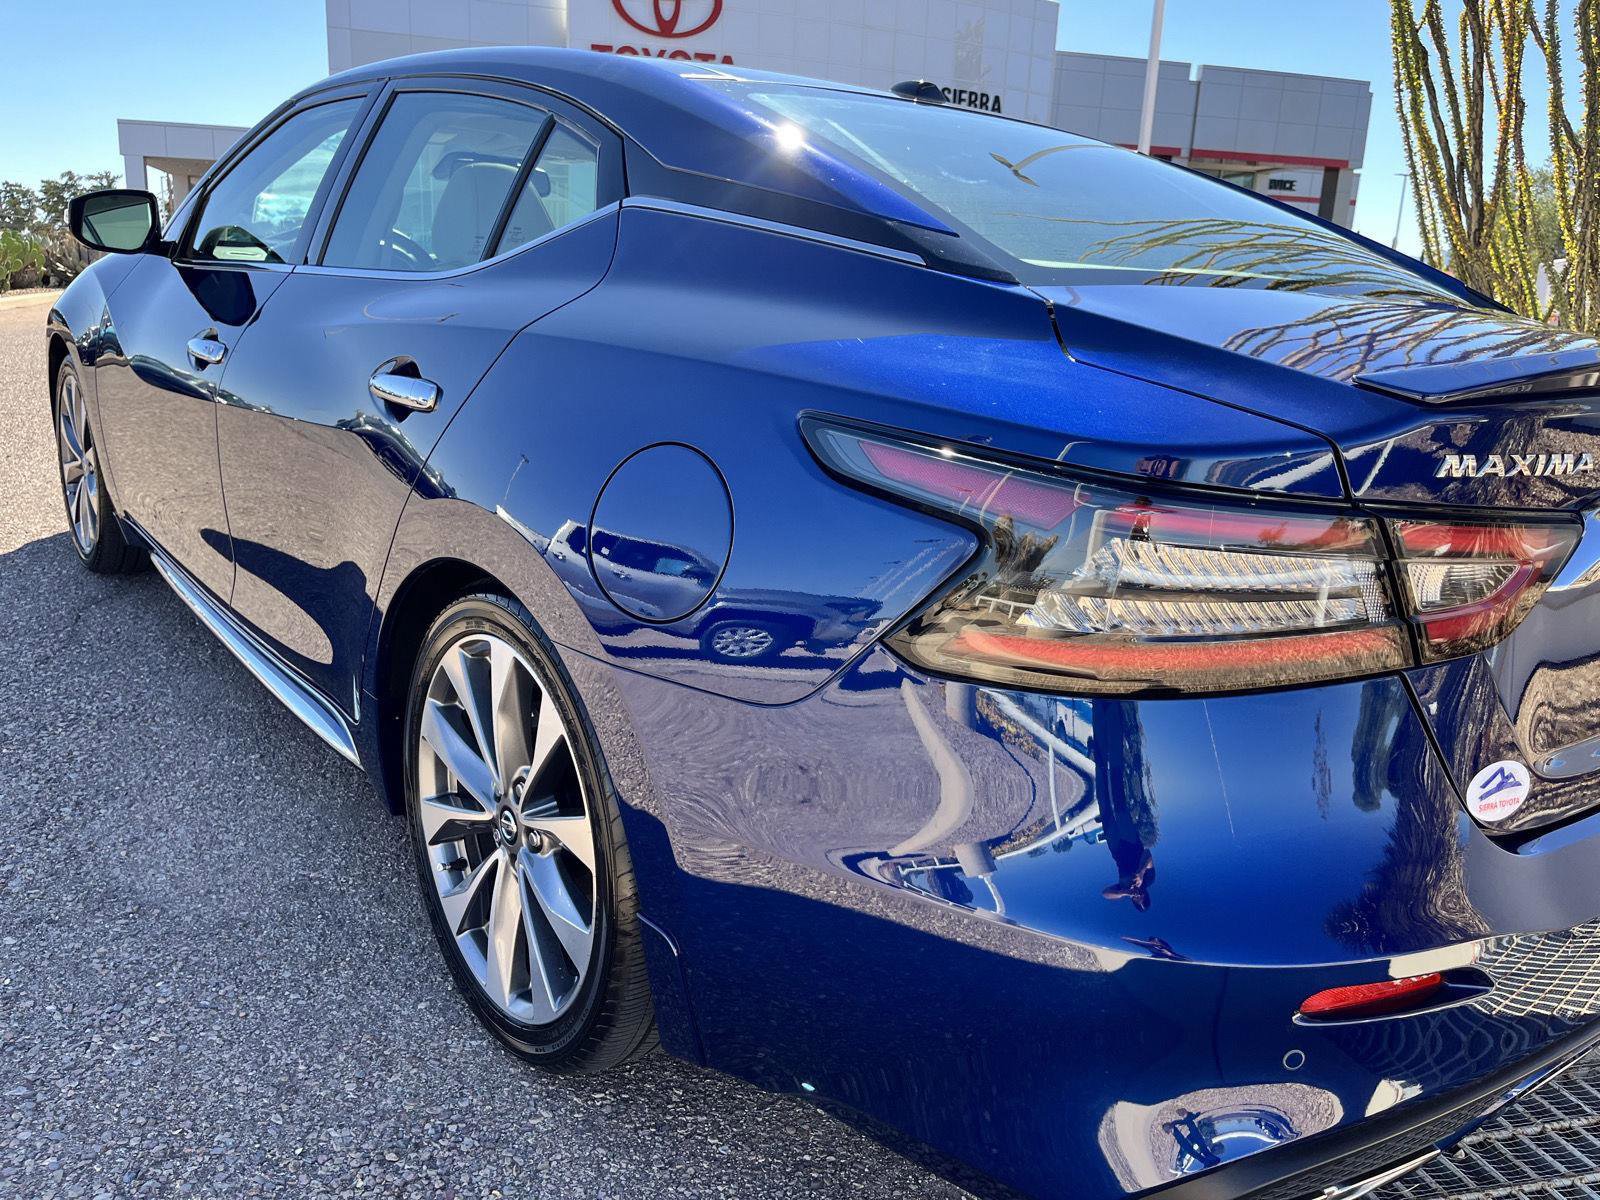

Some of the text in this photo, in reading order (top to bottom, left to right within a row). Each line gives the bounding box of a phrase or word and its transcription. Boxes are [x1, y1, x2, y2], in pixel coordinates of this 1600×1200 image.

[941, 87, 1002, 113] SIERRA
[1435, 453, 1594, 478] MAXIMA
[1478, 797, 1520, 812] SIERRA TOYOTA
